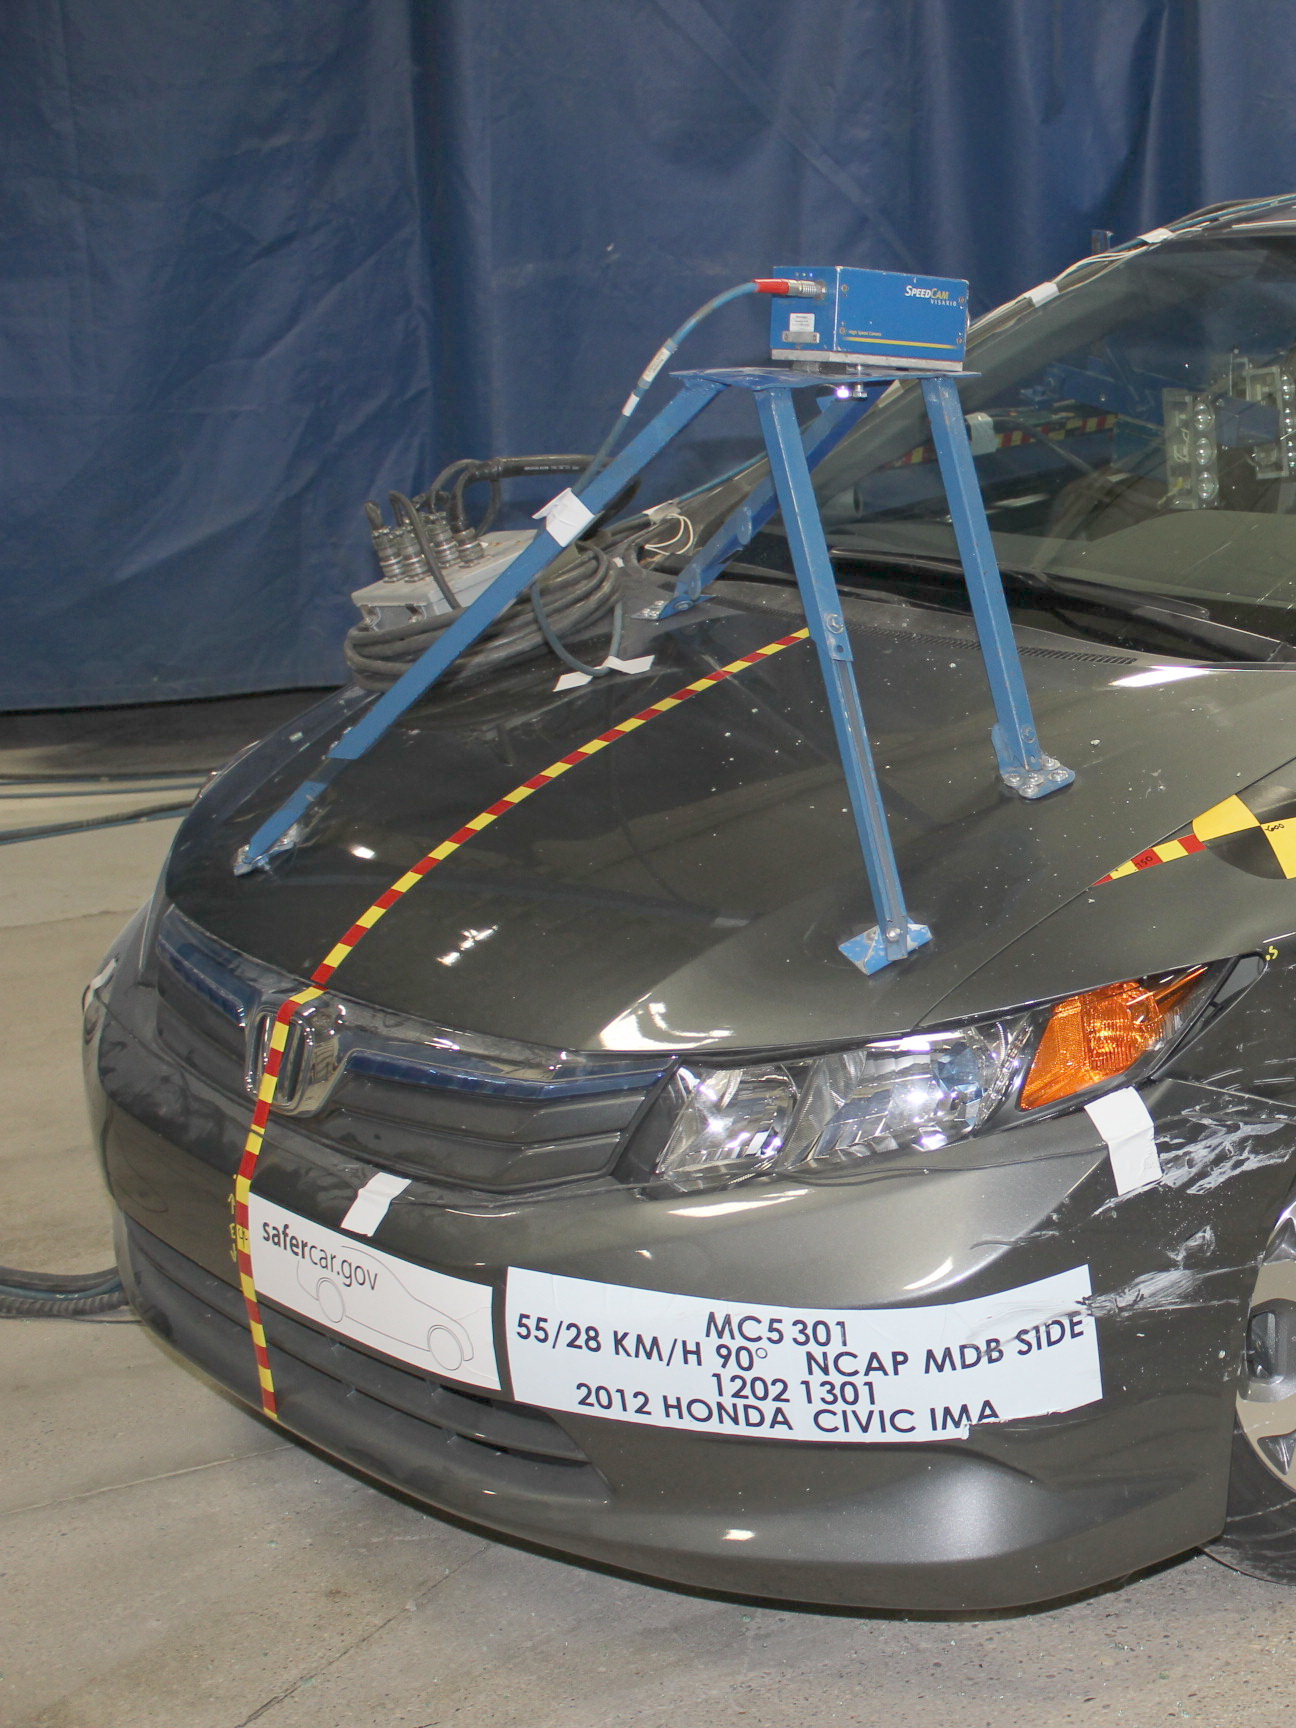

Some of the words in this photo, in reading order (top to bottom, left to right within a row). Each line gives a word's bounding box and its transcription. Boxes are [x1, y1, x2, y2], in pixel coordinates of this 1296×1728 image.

[930, 299, 957, 307] VISARIO
[262, 1221, 378, 1291] safercar.gov
[516, 1313, 602, 1353] 55/28
[613, 1330, 702, 1366] KM/H
[805, 1351, 909, 1377] NCAP
[924, 1338, 1004, 1374] MDB
[1015, 1311, 1085, 1356] SIDE
[576, 1382, 652, 1415] 2012
[662, 1395, 794, 1430] HONDA
[813, 1409, 916, 1433] CIVIC
[929, 1399, 1000, 1431] IMA
